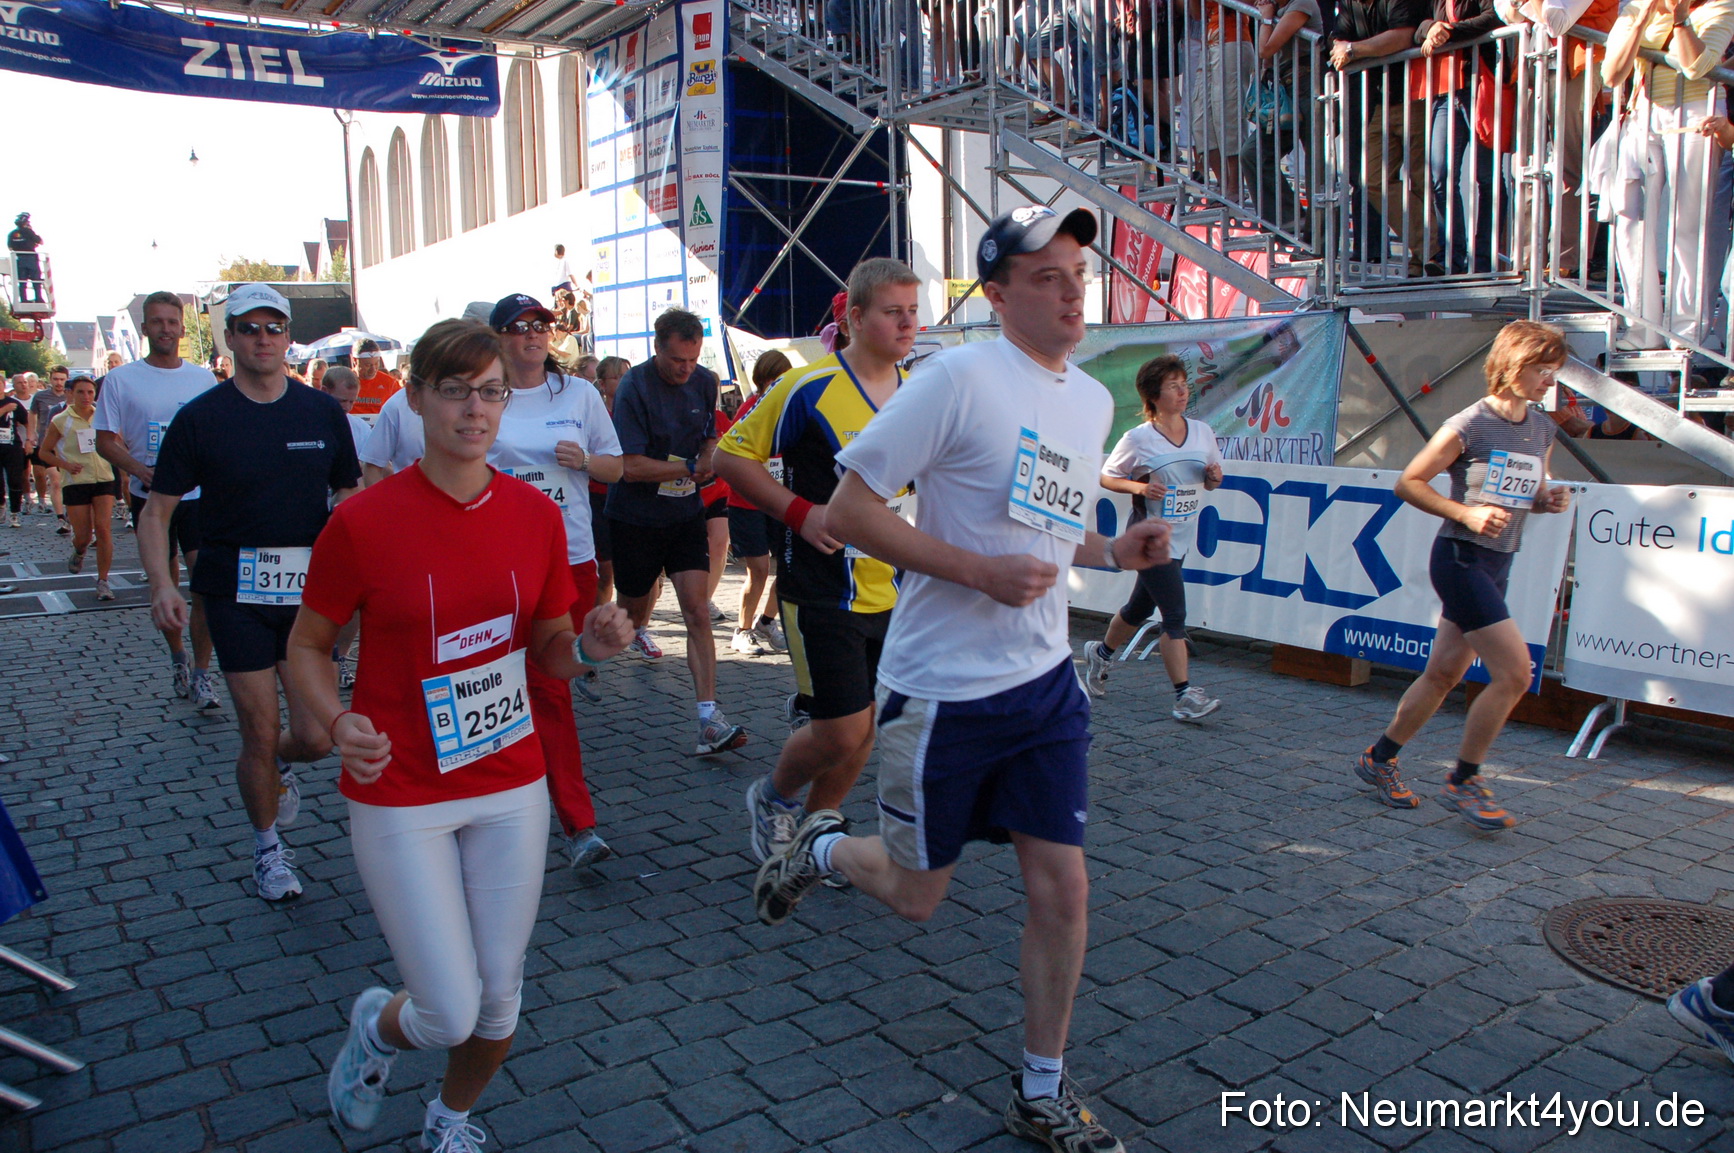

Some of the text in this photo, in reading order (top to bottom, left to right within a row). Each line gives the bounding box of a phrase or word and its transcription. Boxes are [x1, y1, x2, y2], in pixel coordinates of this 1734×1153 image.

[181, 37, 324, 88] ZIEL
[1019, 461, 1029, 477] D
[1033, 475, 1084, 517] 3042
[1491, 469, 1537, 495] D 2767
[1588, 509, 1734, 555] Gute Id
[257, 551, 281, 565] Jörg
[243, 566, 307, 589] D 3170
[459, 628, 493, 650] DEHN
[455, 671, 503, 700] Nicole
[436, 712, 451, 728] B
[464, 687, 525, 739] 2524
